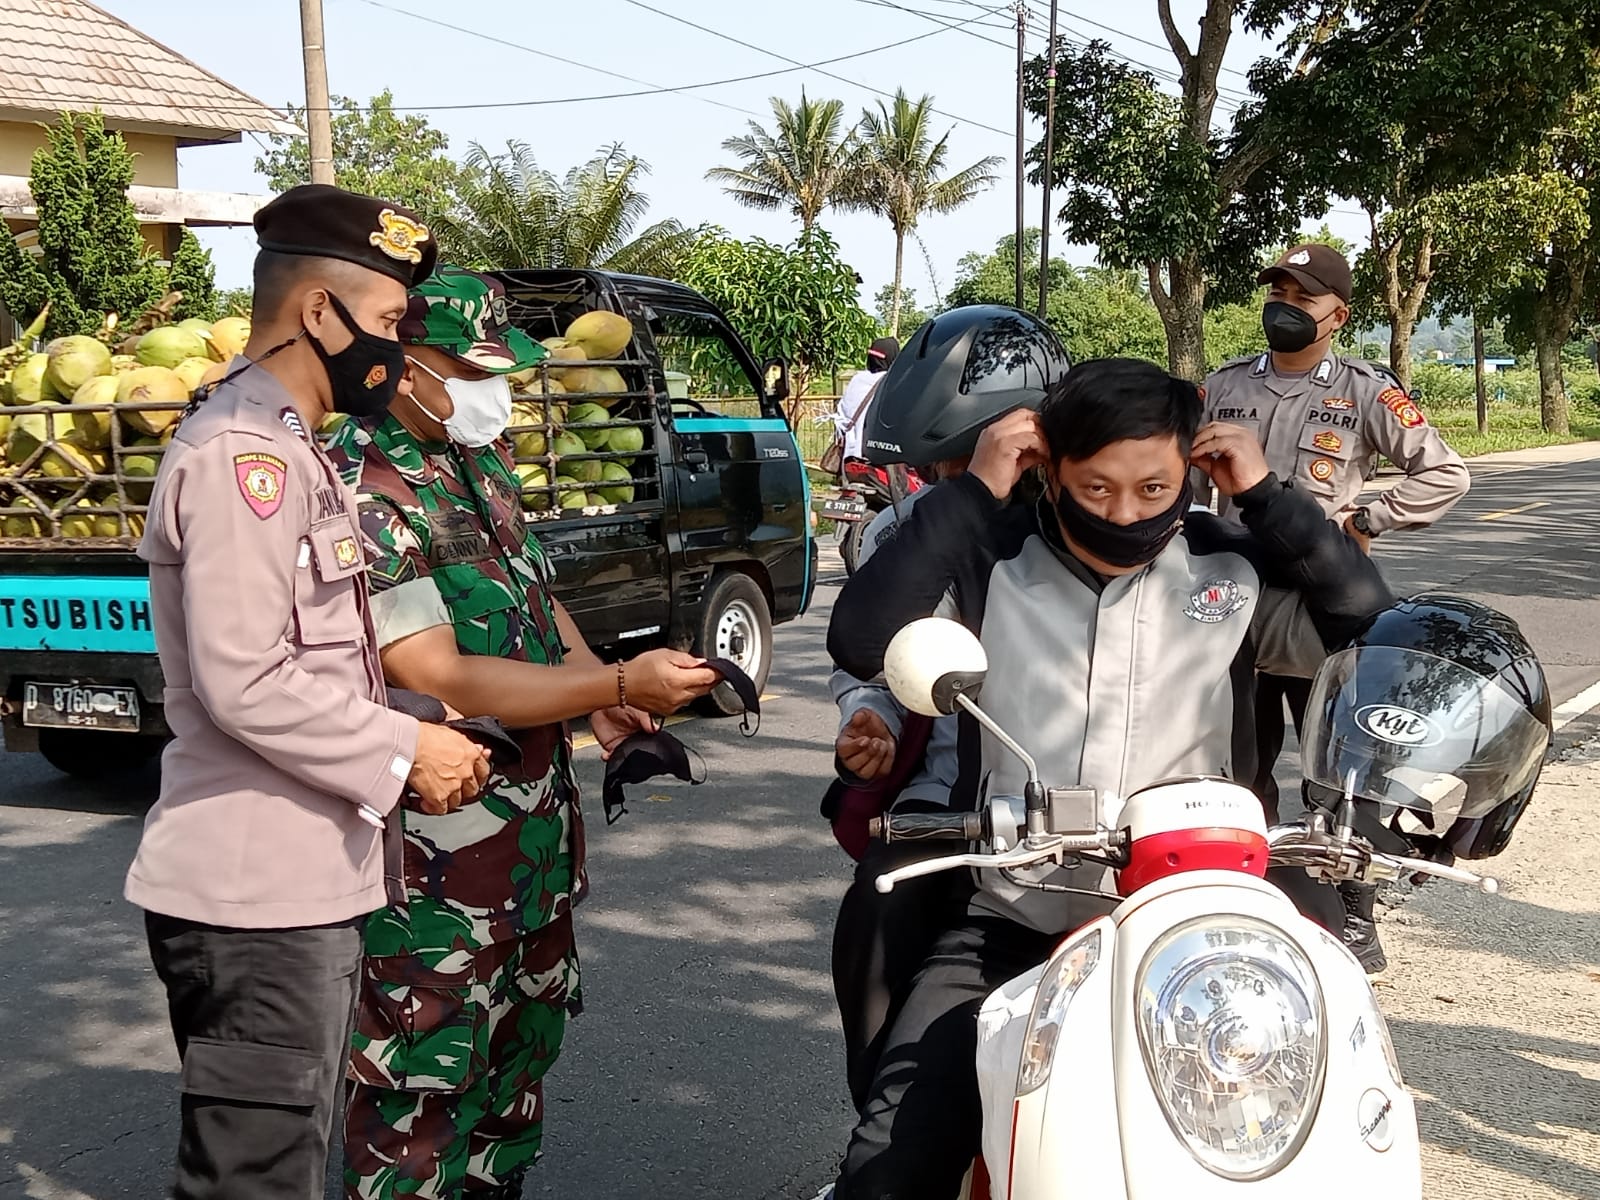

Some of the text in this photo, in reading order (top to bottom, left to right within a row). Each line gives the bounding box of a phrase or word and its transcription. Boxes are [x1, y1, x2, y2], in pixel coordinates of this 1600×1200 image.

[1249, 408, 1257, 418] A
[1308, 409, 1358, 430] POLRI
[866, 440, 902, 453] HONDA
[53, 687, 94, 714] 8760
[113, 690, 138, 716] EX
